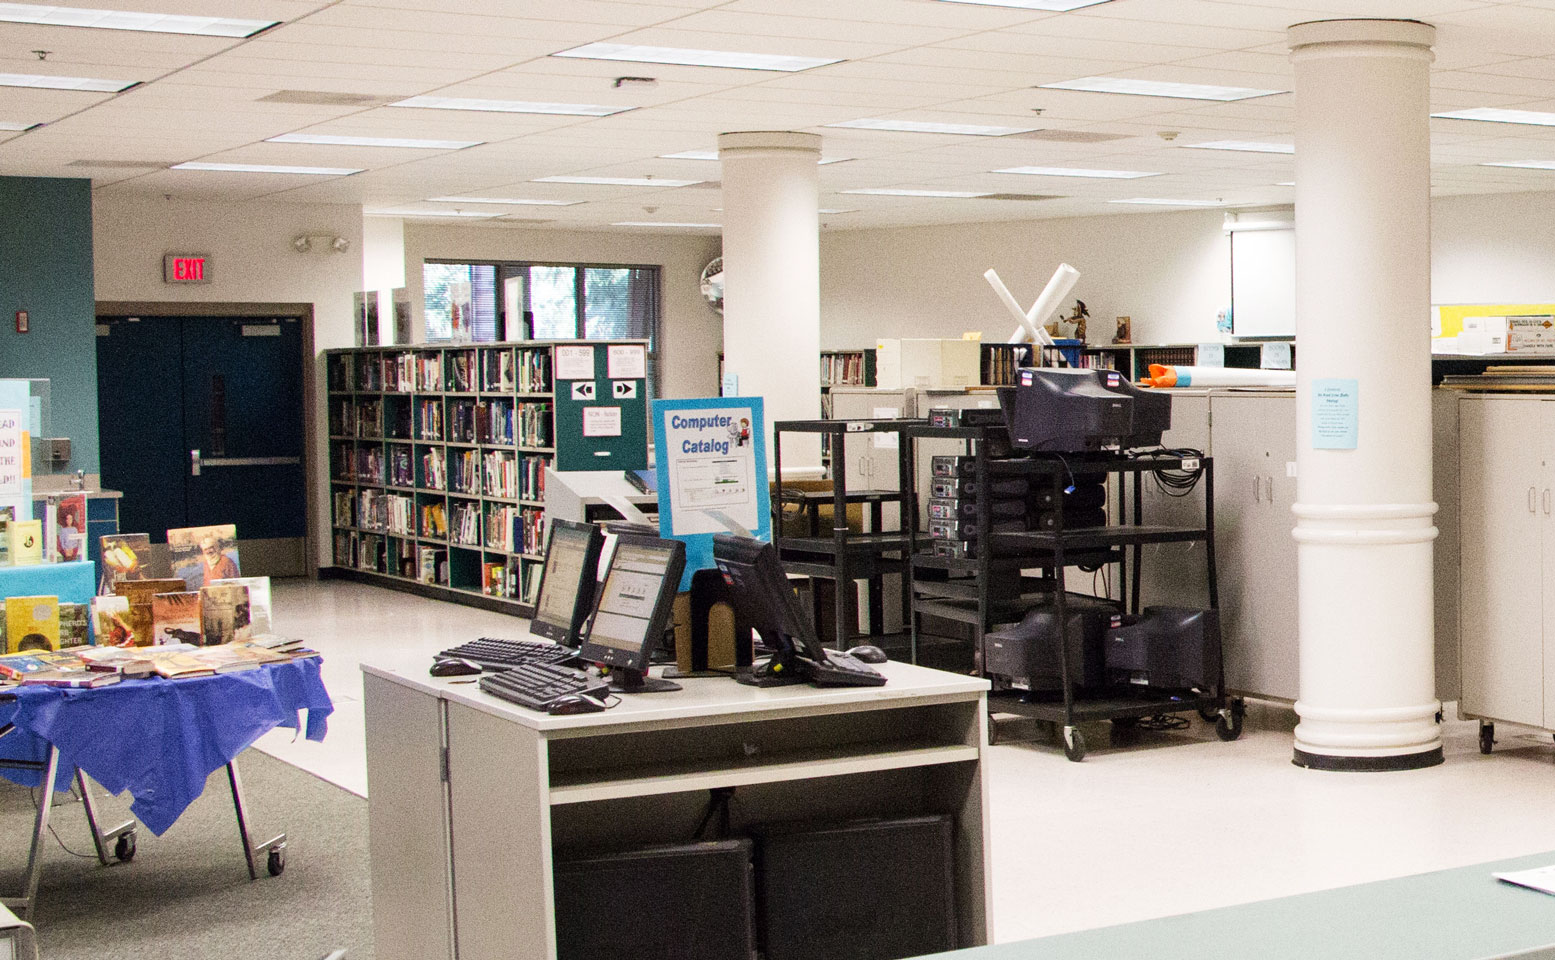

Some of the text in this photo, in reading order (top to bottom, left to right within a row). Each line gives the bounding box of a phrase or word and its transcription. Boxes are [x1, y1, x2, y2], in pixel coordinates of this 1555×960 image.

[173, 258, 205, 280] EXIT
[672, 414, 732, 431] Computer
[682, 439, 729, 455] Catalog
